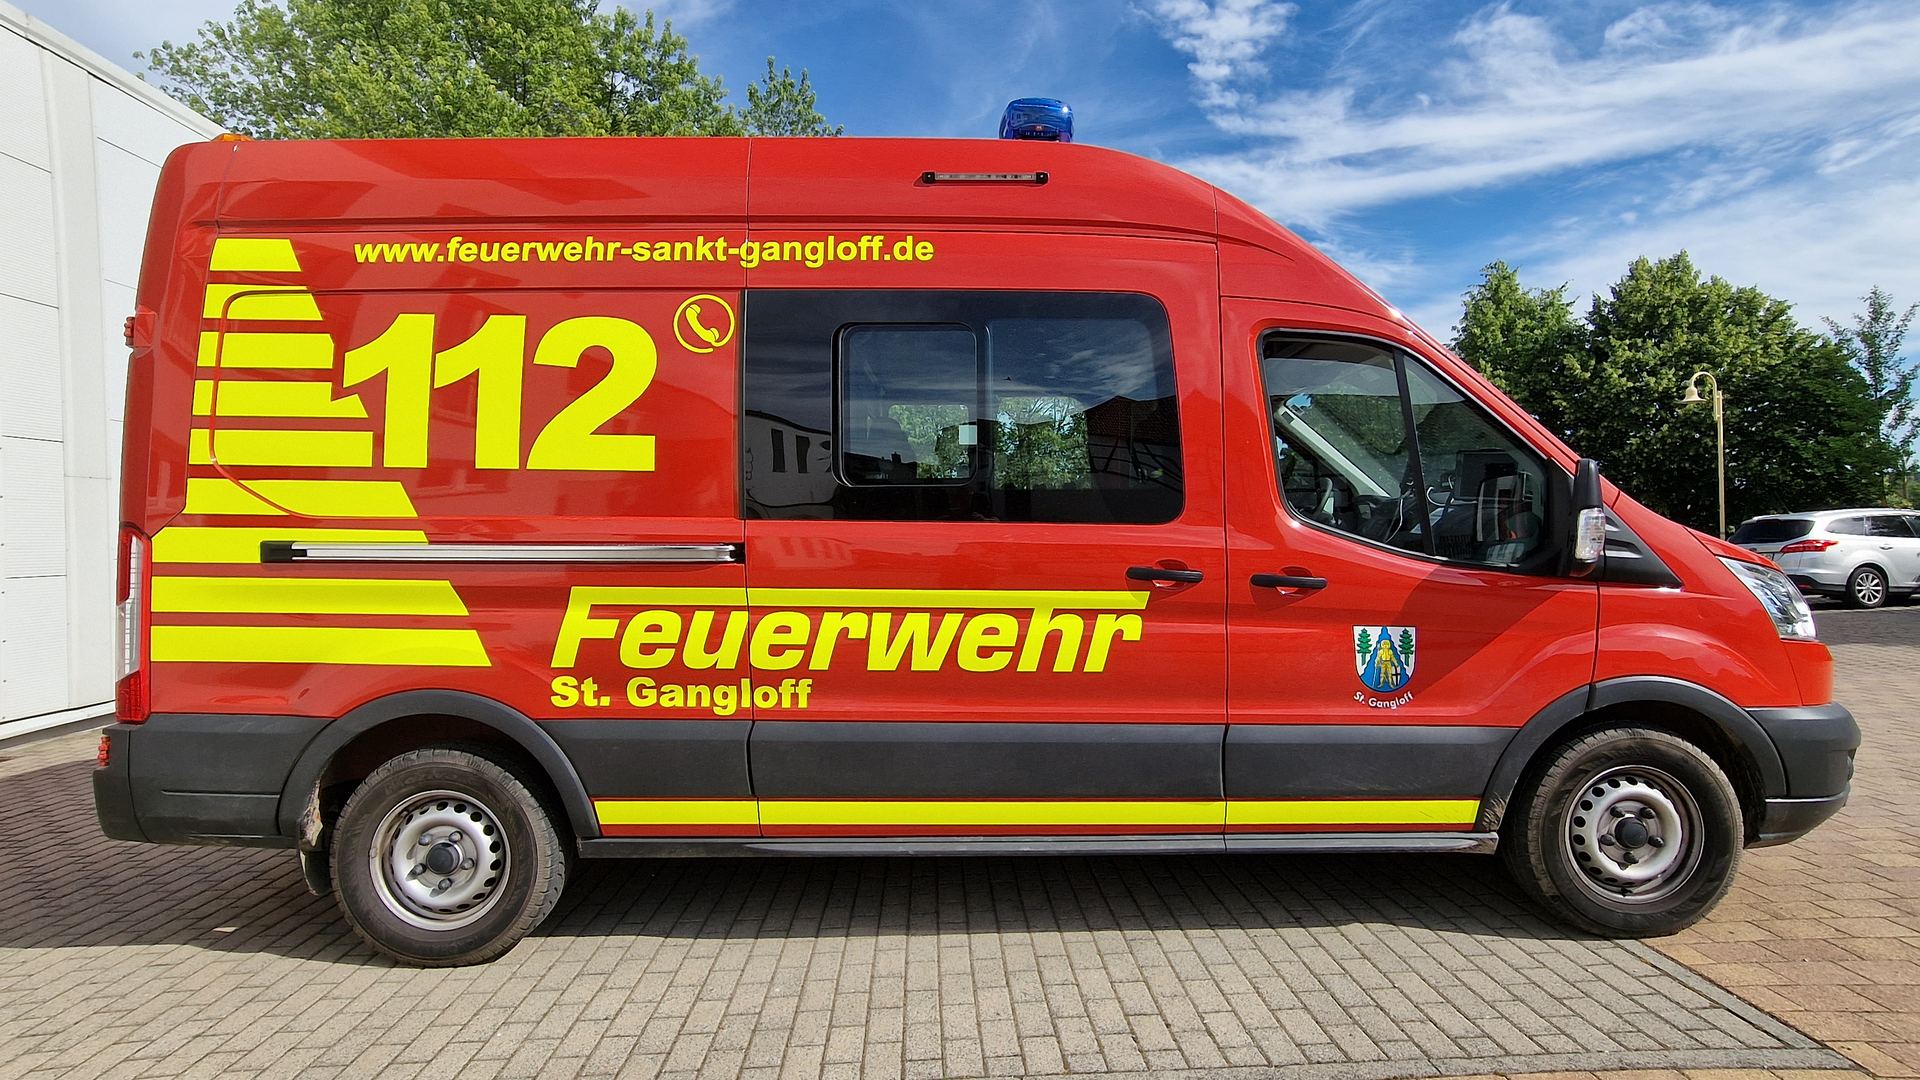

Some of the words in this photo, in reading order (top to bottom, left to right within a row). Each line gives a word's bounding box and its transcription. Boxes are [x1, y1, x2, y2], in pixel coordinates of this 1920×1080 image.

[353, 235, 935, 269] www.feuerwehr-sankt-gangloff.de
[342, 313, 658, 472] 112
[550, 585, 1151, 673] Feuerwehr
[550, 675, 611, 708] St.
[626, 676, 813, 717] Gangloff
[1353, 691, 1366, 705] St.
[1368, 691, 1414, 710] Gangloff
